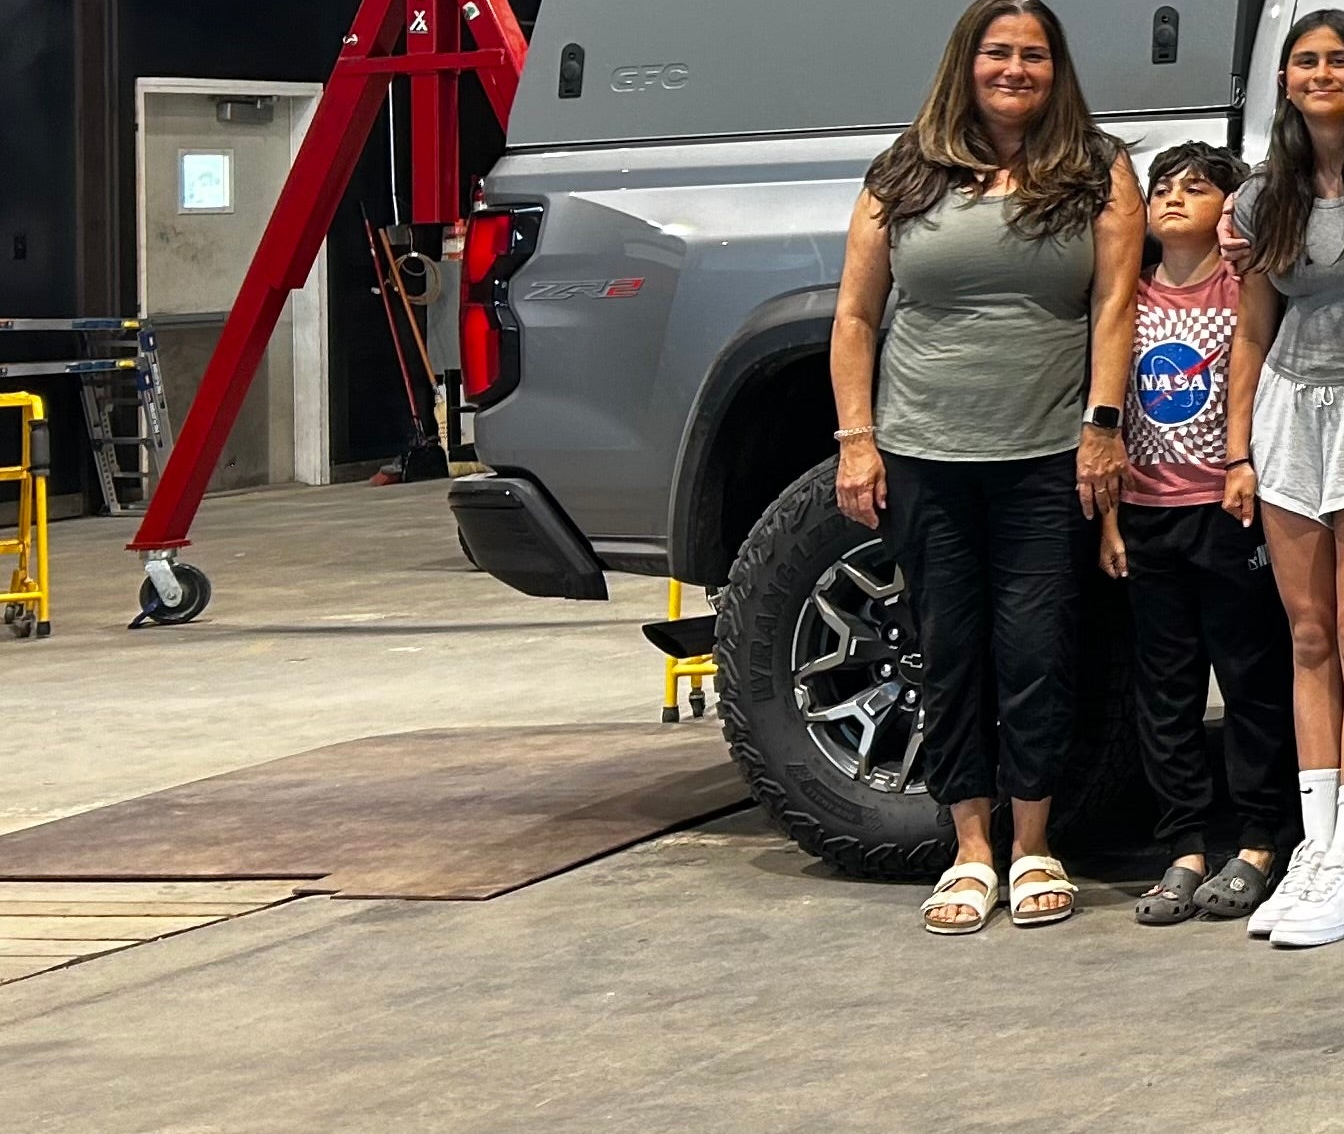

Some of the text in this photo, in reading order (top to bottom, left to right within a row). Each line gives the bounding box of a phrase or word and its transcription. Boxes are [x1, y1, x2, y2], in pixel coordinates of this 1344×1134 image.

[610, 63, 689, 93] GFC
[524, 276, 646, 302] ZR2
[1140, 373, 1208, 391] NASA
[751, 514, 848, 702] WRANGLE
